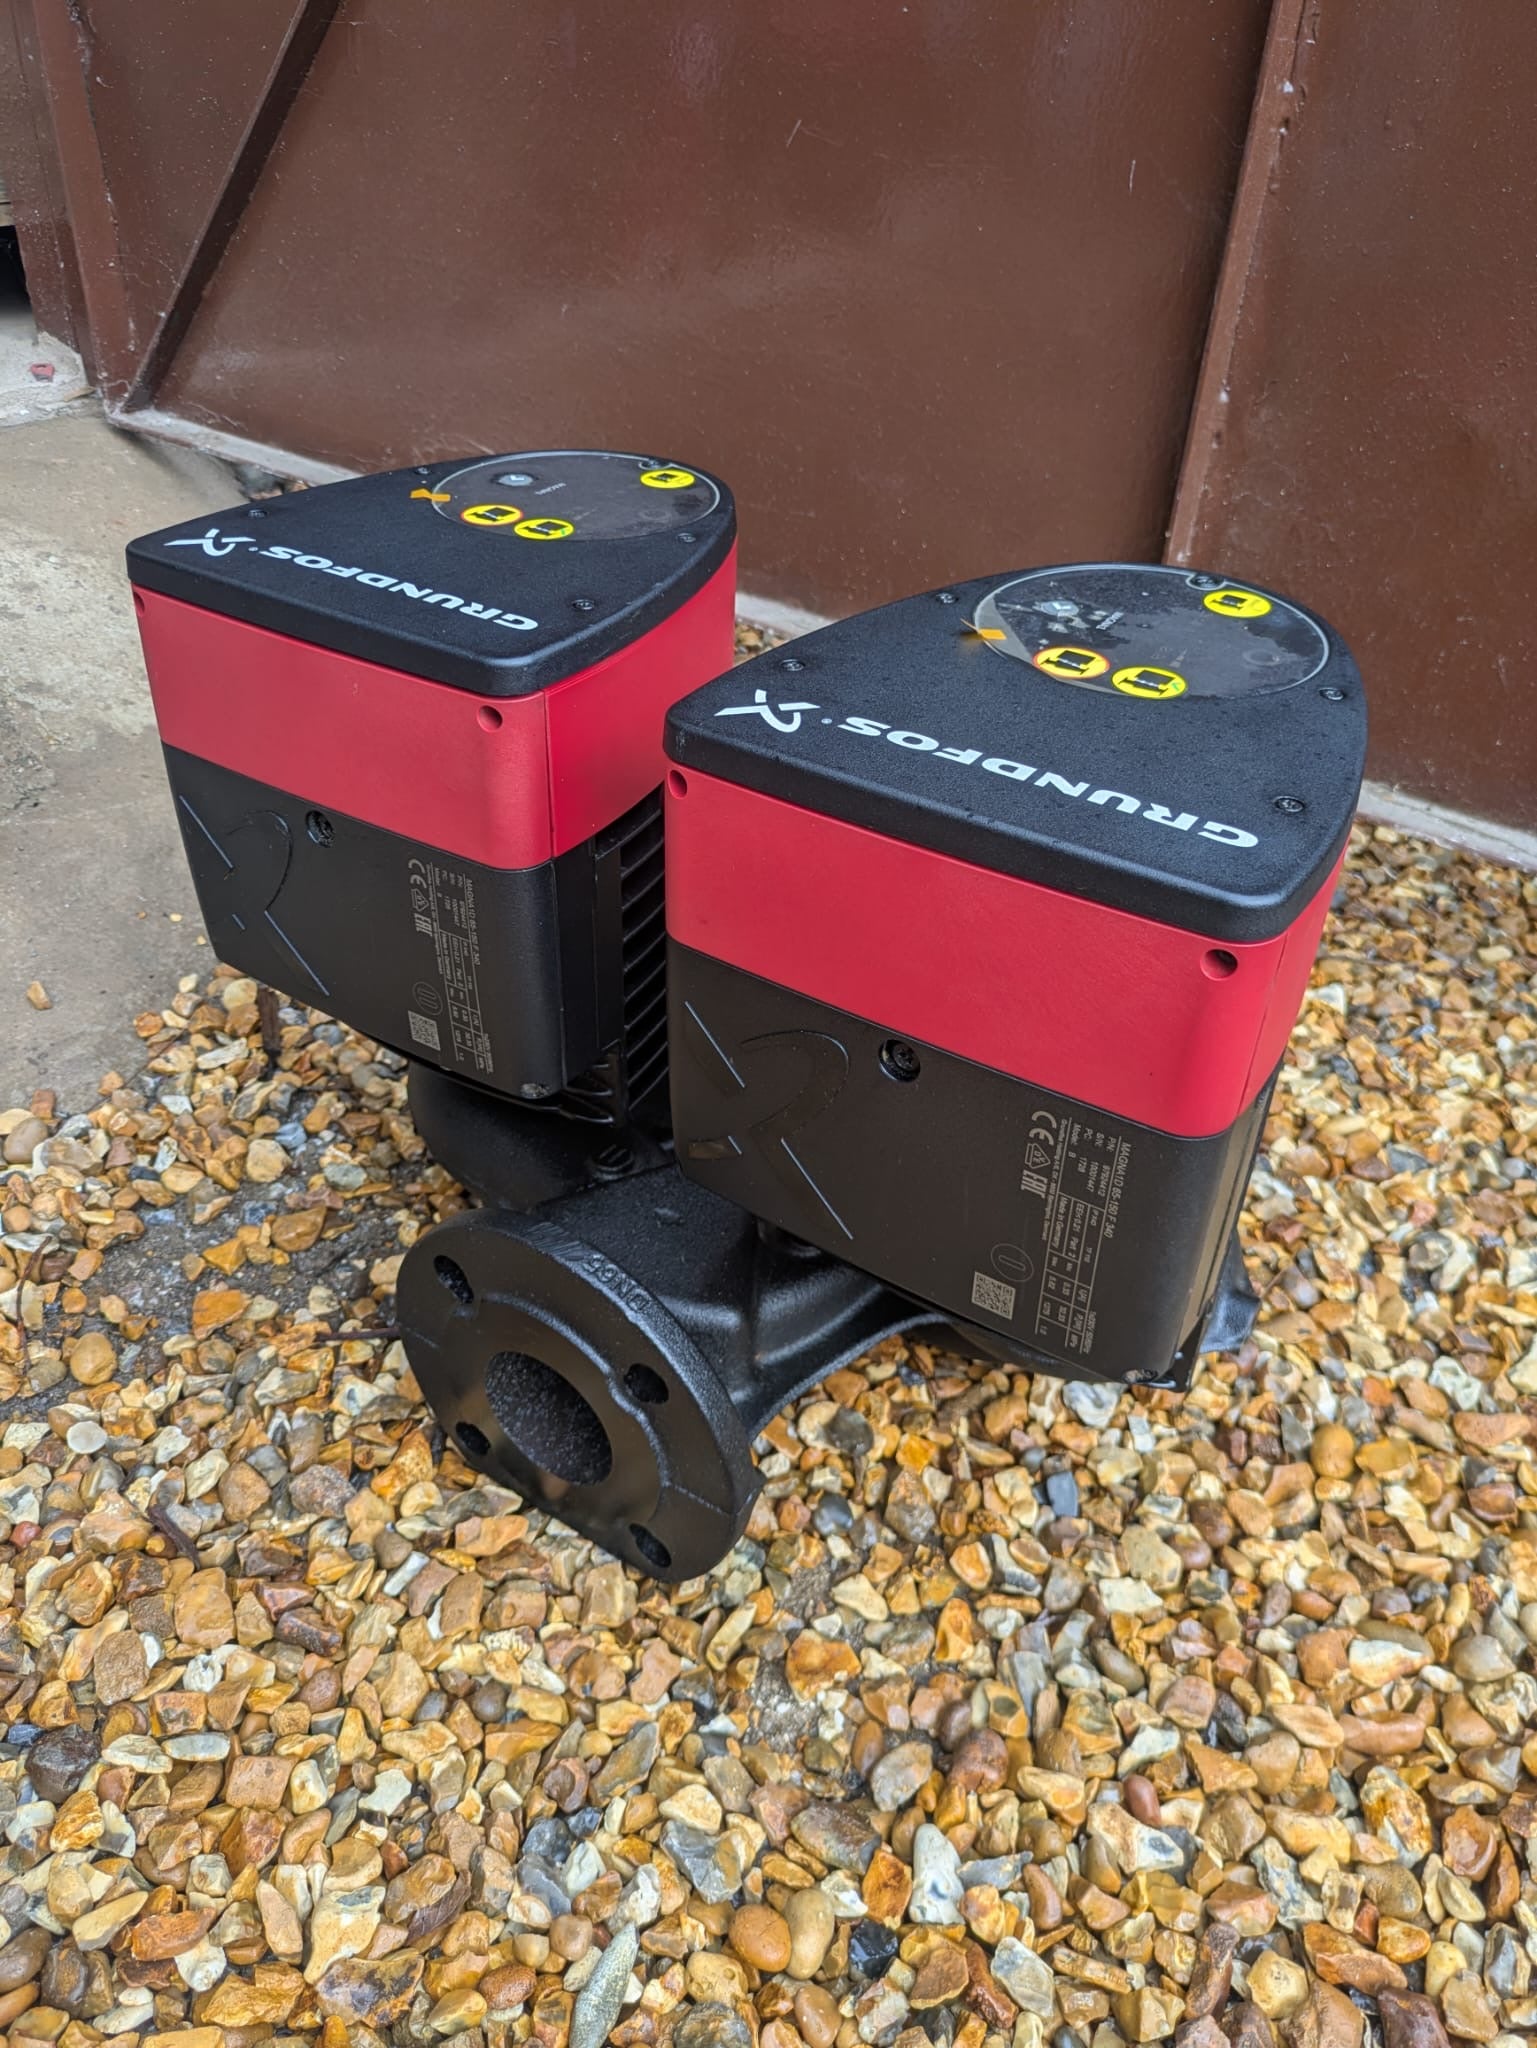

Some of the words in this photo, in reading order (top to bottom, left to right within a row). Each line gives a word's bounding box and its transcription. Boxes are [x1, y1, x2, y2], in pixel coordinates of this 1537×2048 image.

[259, 546, 539, 630] GRUNDFOS
[838, 716, 1259, 848] GRUNDFOS
[1029, 1111, 1057, 1146] CE
[1114, 1141, 1131, 1187] MAGNA1D
[1059, 1197, 1068, 1214] Made
[1108, 1187, 1121, 1215] 65-150
[1052, 1220, 1064, 1249] Germany
[1104, 1222, 1115, 1238] 340
